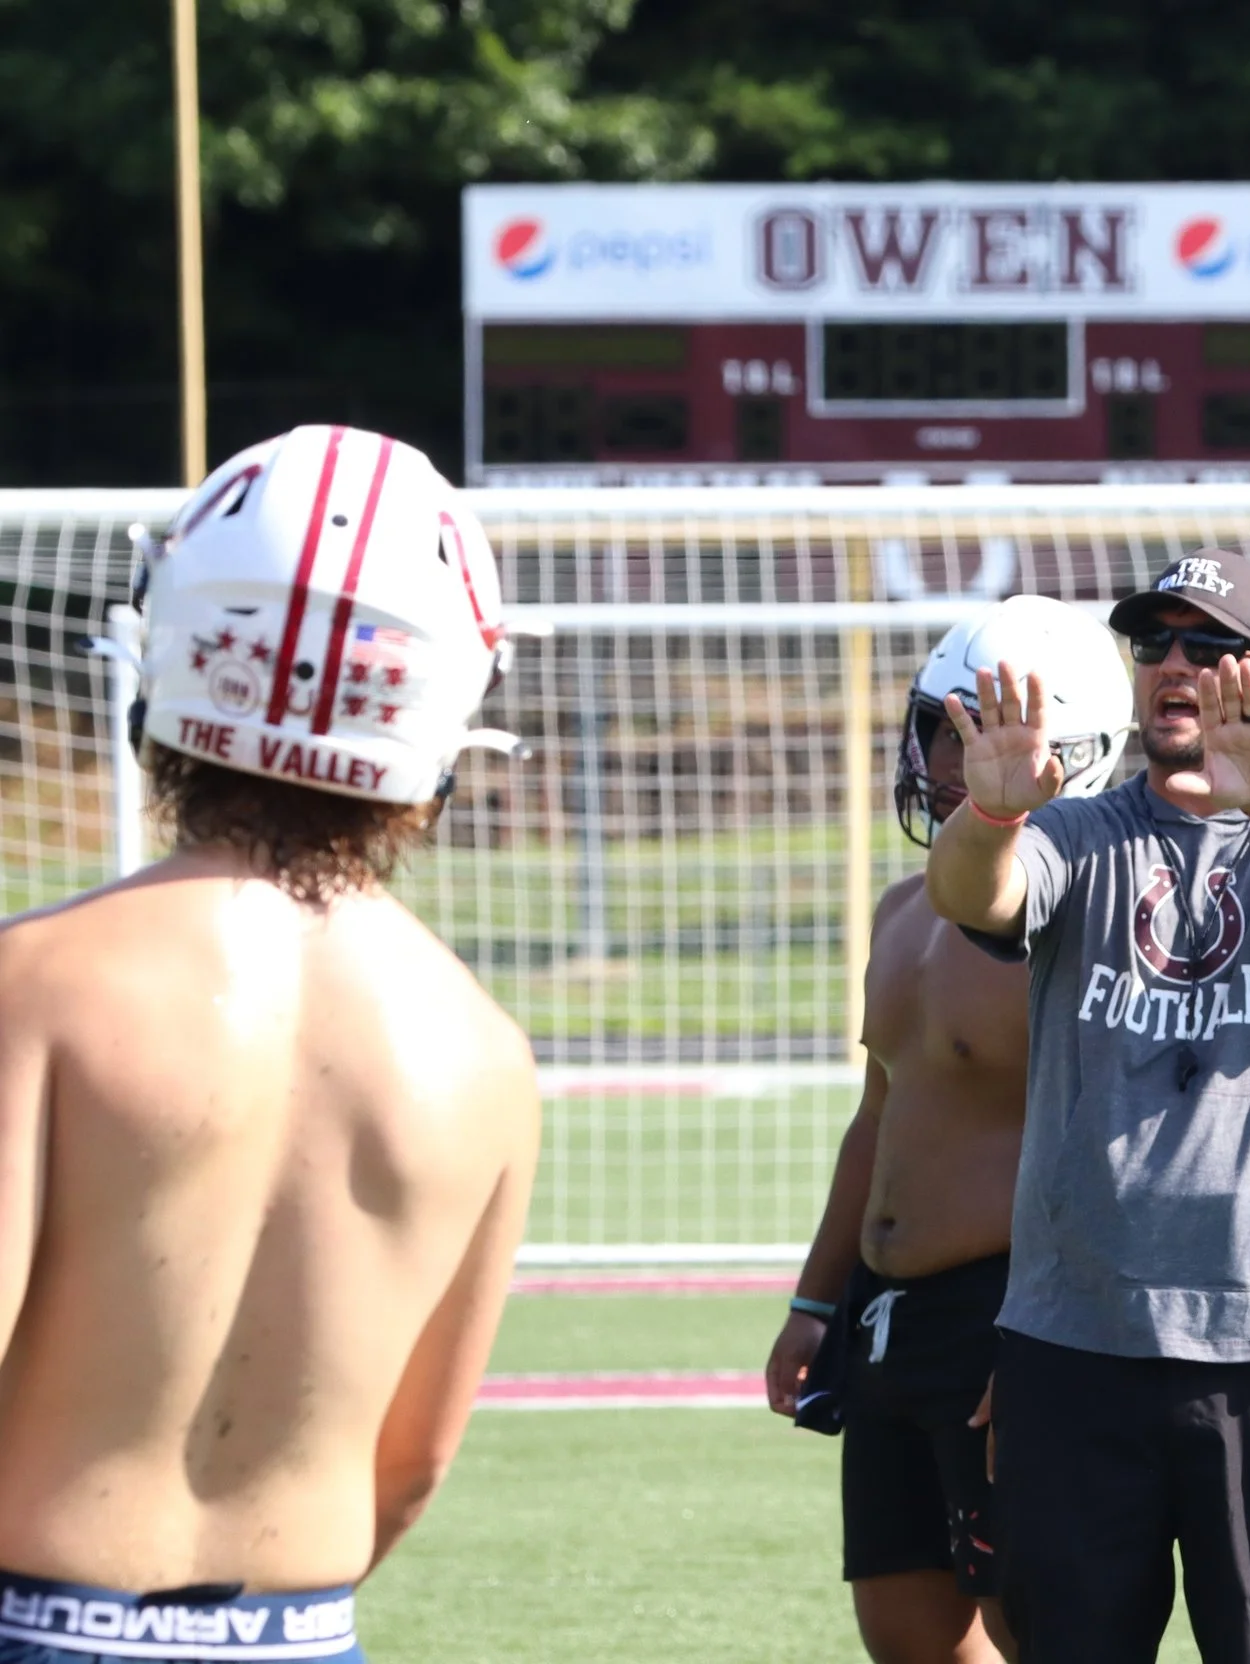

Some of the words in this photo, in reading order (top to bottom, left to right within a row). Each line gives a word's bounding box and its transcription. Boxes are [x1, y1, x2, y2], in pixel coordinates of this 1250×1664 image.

[751, 204, 1137, 292] OWEN
[1158, 573, 1235, 598] VALLEY
[1178, 557, 1222, 576] THE
[178, 716, 237, 760] THE
[258, 733, 389, 791] VALLEY
[0, 1586, 271, 1644] ARMOUR
